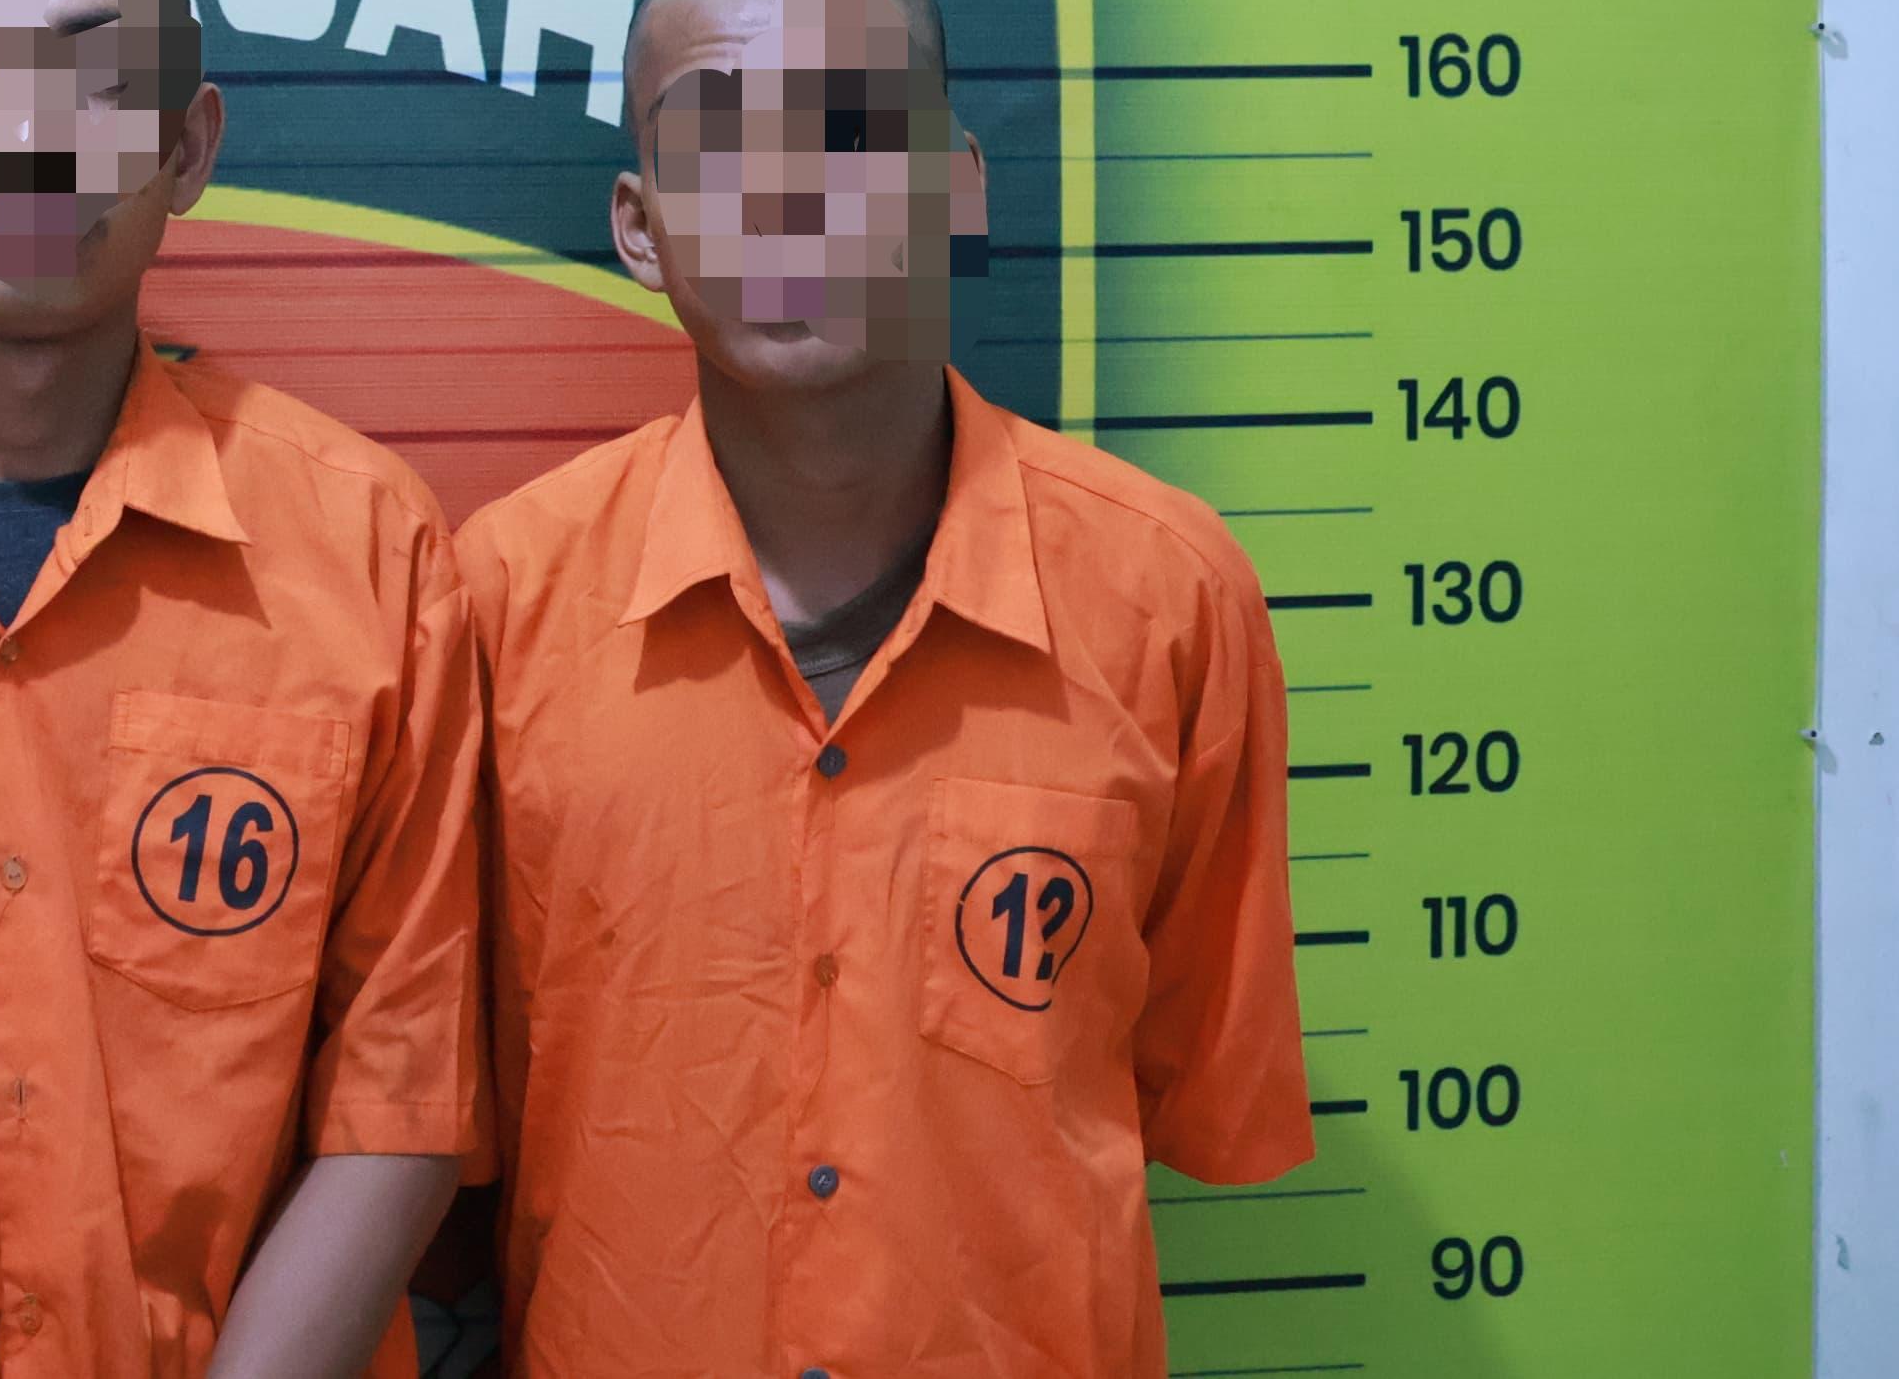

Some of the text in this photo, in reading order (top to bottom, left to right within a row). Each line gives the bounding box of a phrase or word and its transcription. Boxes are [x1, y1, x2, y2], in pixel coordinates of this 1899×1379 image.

[1399, 33, 1521, 98] 160
[1400, 207, 1522, 273] 150
[1398, 375, 1521, 441] 140
[1404, 559, 1523, 626] 130
[1402, 729, 1520, 796] 120
[170, 794, 274, 910] 16
[1422, 893, 1518, 959] 110
[1399, 1063, 1520, 1131] 100
[1431, 1234, 1523, 1300] 90
